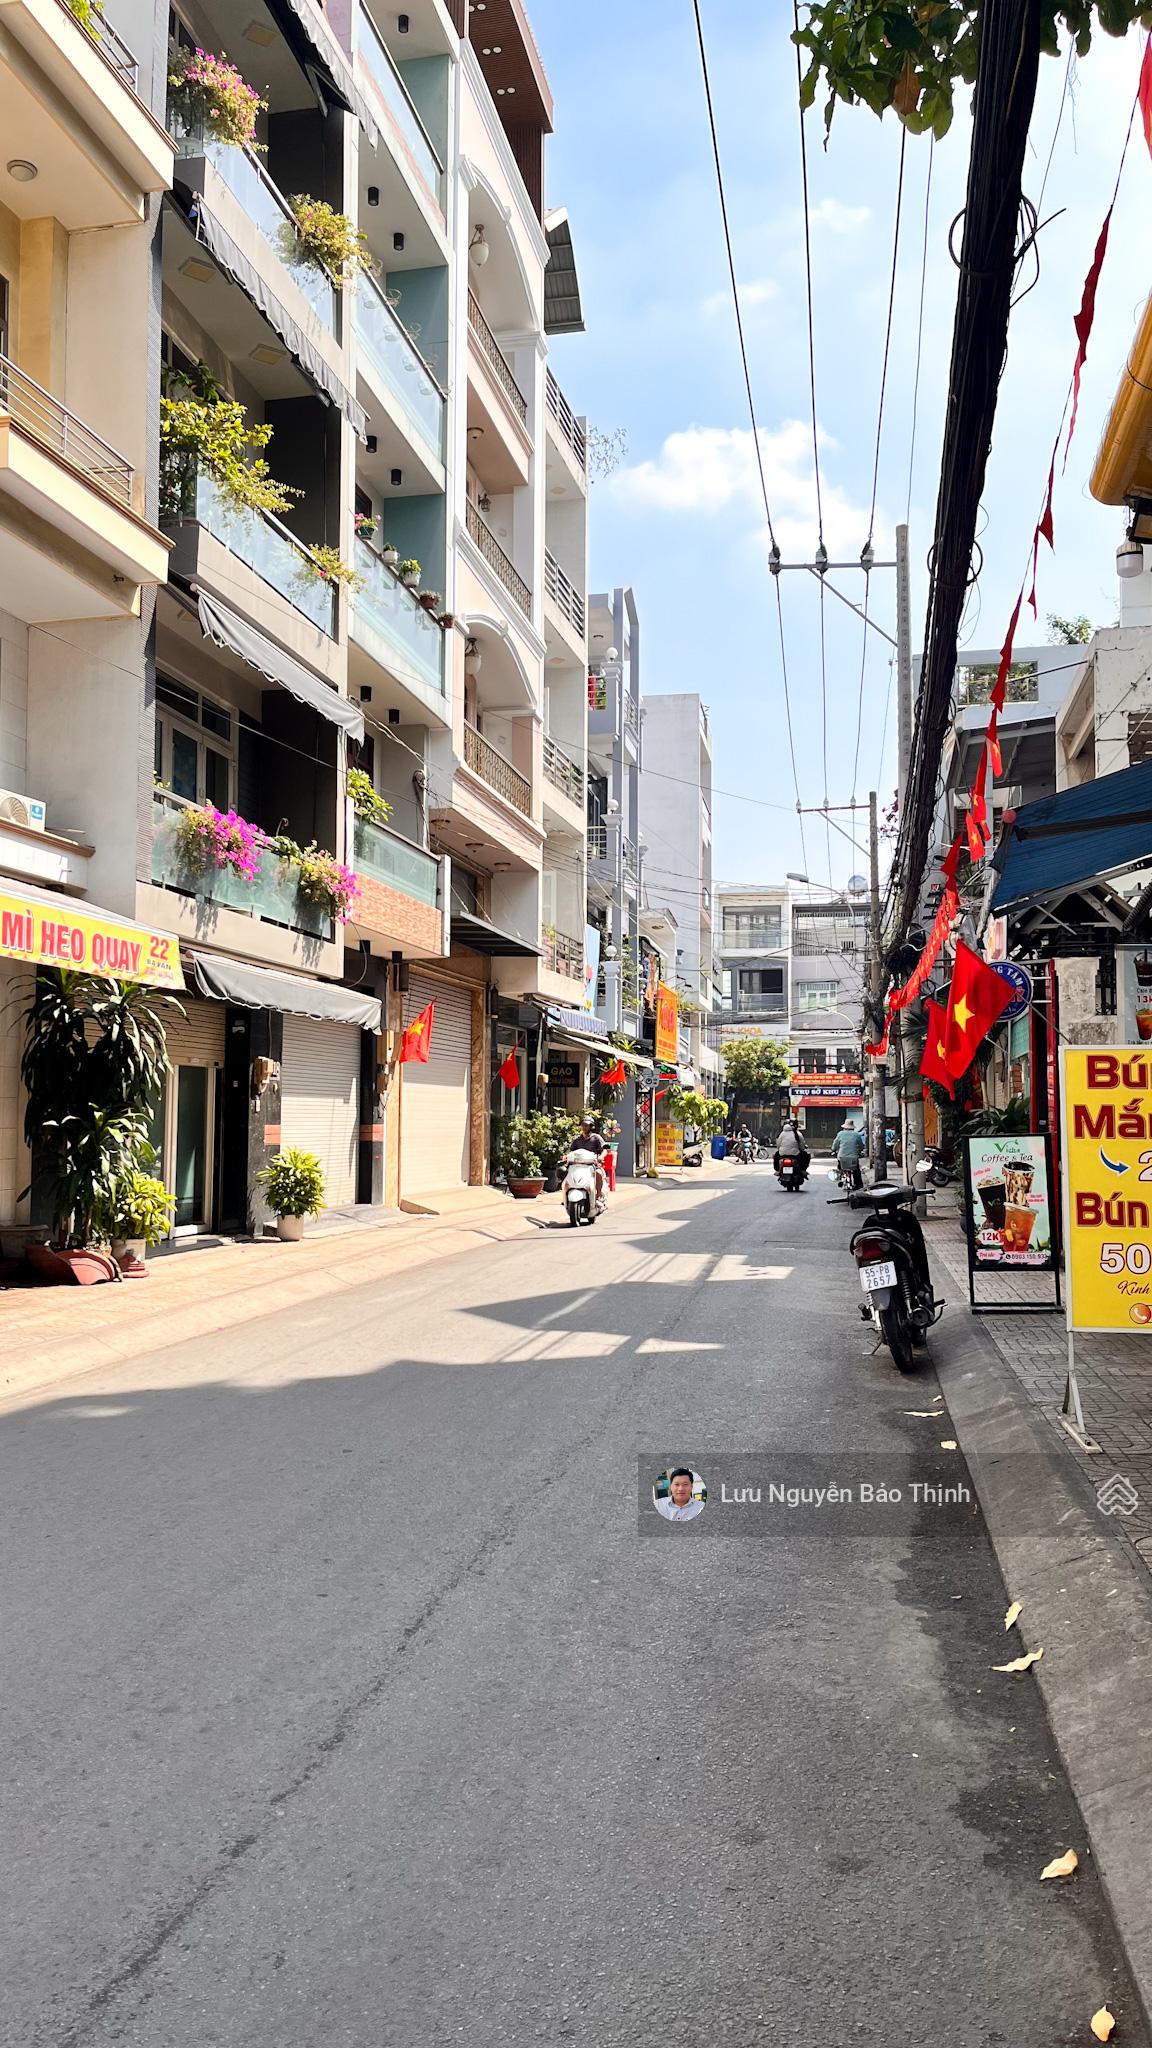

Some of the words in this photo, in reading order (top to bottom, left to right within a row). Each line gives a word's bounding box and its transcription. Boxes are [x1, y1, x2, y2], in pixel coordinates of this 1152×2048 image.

[2, 909, 33, 953] MÌ
[41, 920, 84, 962] HEO
[92, 933, 142, 973] QUAY
[150, 935, 170, 961] 22
[1087, 1054, 1152, 1089] Bú
[1073, 1098, 1152, 1139] Mắ
[981, 1153, 1010, 1163] Coffee
[1019, 1153, 1033, 1161] Tea
[1075, 1191, 1150, 1228] Bún
[982, 1232, 999, 1241] 12K
[865, 1265, 890, 1278] 55-P8
[1100, 1243, 1152, 1275] 50
[867, 1275, 891, 1288] 2657
